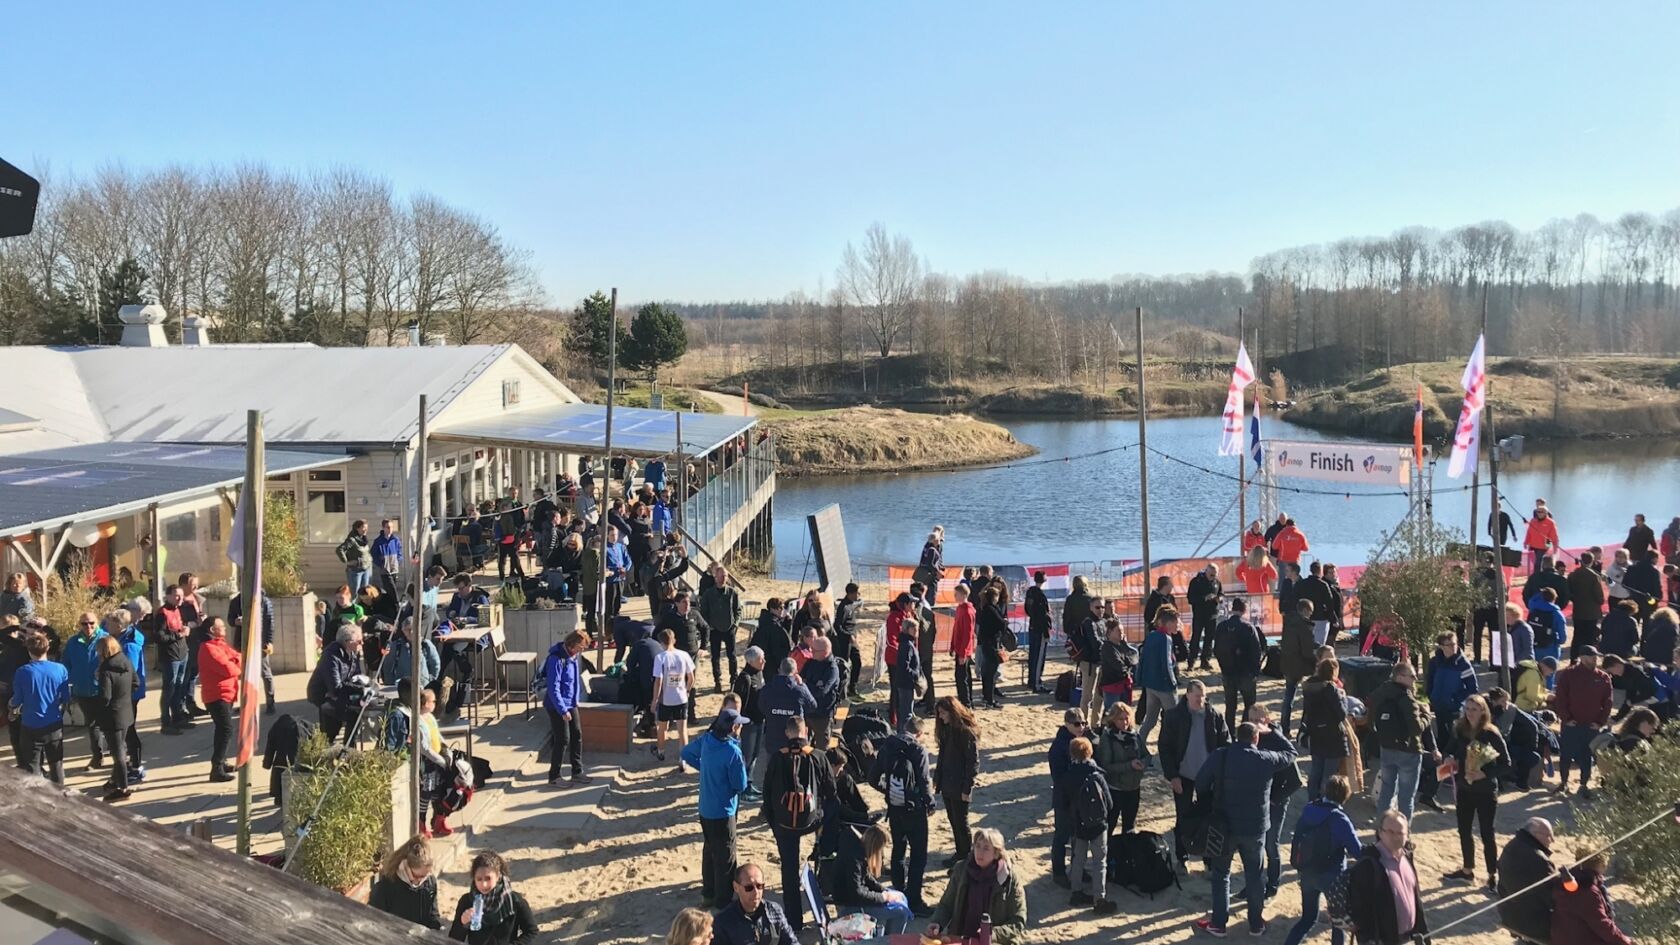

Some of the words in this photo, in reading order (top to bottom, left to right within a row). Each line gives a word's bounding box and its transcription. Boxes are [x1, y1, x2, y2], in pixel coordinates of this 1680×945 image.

[1310, 452, 1355, 473] Finish
[771, 708, 795, 716] CREW
[889, 773, 906, 807] NIKE
